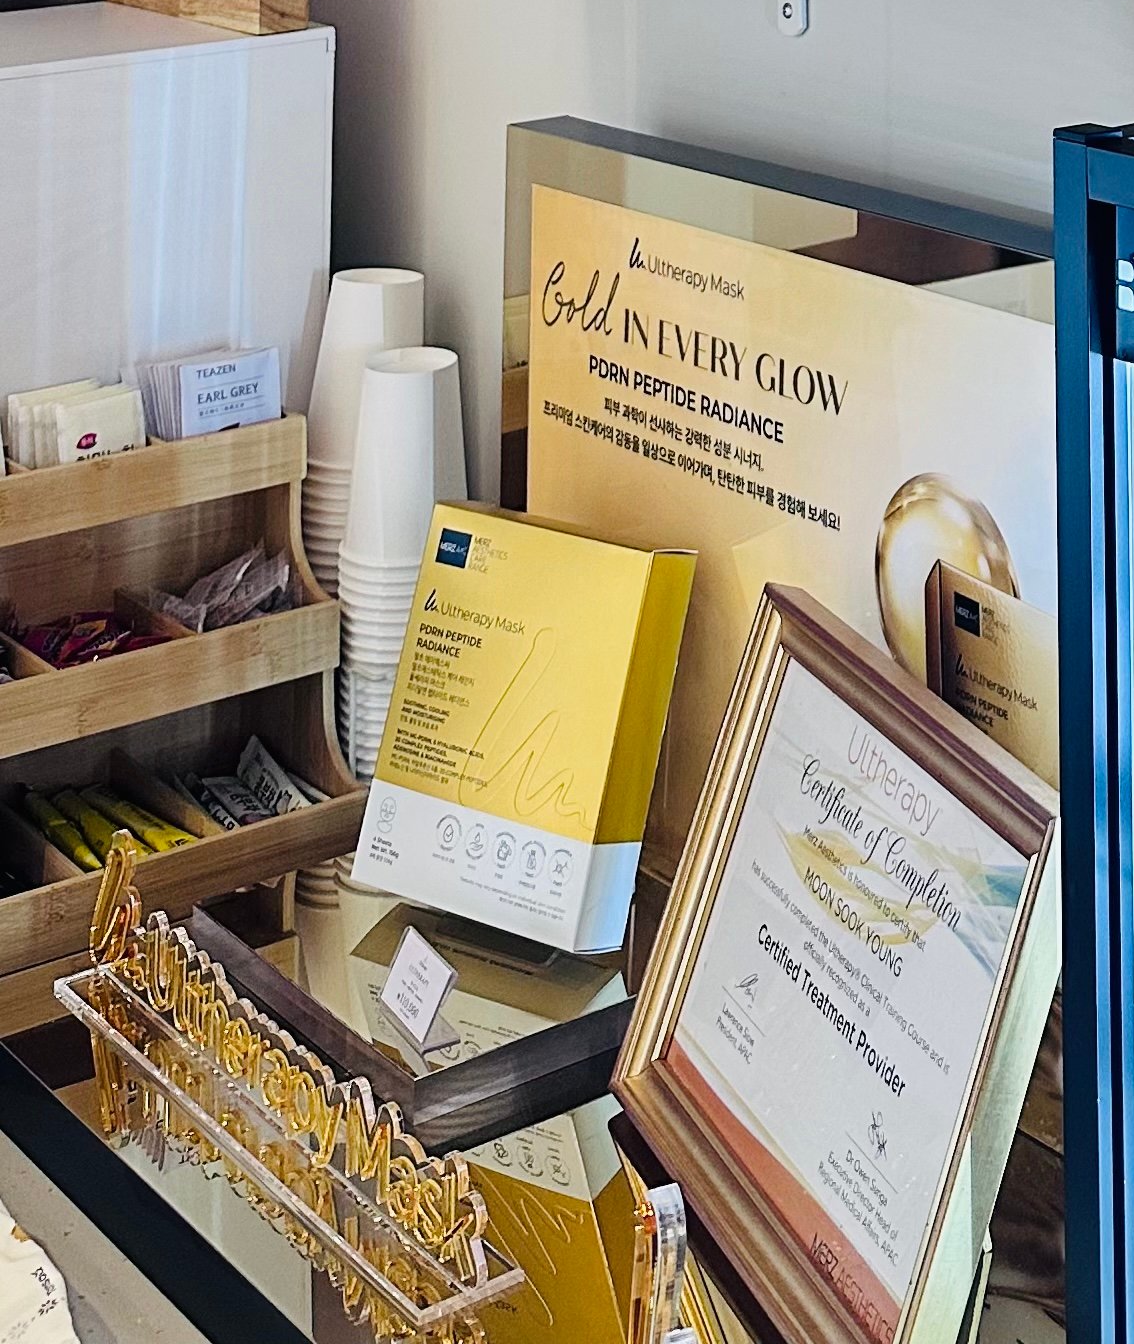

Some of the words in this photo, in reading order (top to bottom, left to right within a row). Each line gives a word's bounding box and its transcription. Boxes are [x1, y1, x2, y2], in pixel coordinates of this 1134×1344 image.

[648, 255, 708, 293] Ultherapy
[710, 272, 745, 301] Mask
[541, 261, 620, 336] Gold
[624, 308, 649, 350] IN
[658, 318, 747, 382] EVERY
[755, 352, 849, 416] GLOW
[196, 363, 236, 380] TEAZEN
[197, 389, 227, 405] EARL
[230, 382, 259, 398] GREY
[589, 354, 629, 387] PDRN
[634, 370, 696, 412] PEPTIDE
[701, 394, 784, 444] RADIANCE
[604, 397, 620, 416] 피부
[622, 402, 647, 426] 과학이
[649, 414, 683, 441] 선사하는
[685, 427, 711, 453] 강력한
[713, 437, 732, 460] 성분
[543, 400, 573, 427] 프리미엄
[575, 413, 614, 443] 스킨케어의
[615, 428, 640, 454] 감동을
[642, 438, 676, 467] 일상으로
[717, 468, 745, 496] 탄탄한
[747, 479, 774, 507] 피부를
[777, 491, 806, 519] 경험해
[808, 503, 840, 532] 보세요!
[416, 637, 461, 658] RADIANCE
[418, 623, 444, 640] PDRN
[446, 629, 483, 649] PEPTIDE
[441, 600, 494, 630] Ultherapy
[495, 615, 526, 636] Mask
[978, 697, 1009, 721] PEPTIDE
[1013, 689, 1038, 712] Mask
[848, 725, 940, 836] Ultherapy
[799, 753, 864, 839] Certificate
[860, 826, 889, 865] of
[884, 829, 962, 933] Completion
[803, 865, 835, 910] MOON
[834, 897, 865, 940] SOOK
[865, 925, 904, 978] YOUNG
[851, 874, 883, 911] honoured
[757, 923, 802, 984] Certified
[801, 968, 856, 1044] Treatment
[855, 1029, 906, 1098] Provider
[860, 973, 883, 1005] Clinical
[882, 995, 907, 1032] Training
[835, 1266, 895, 1341] AESTHETICS
